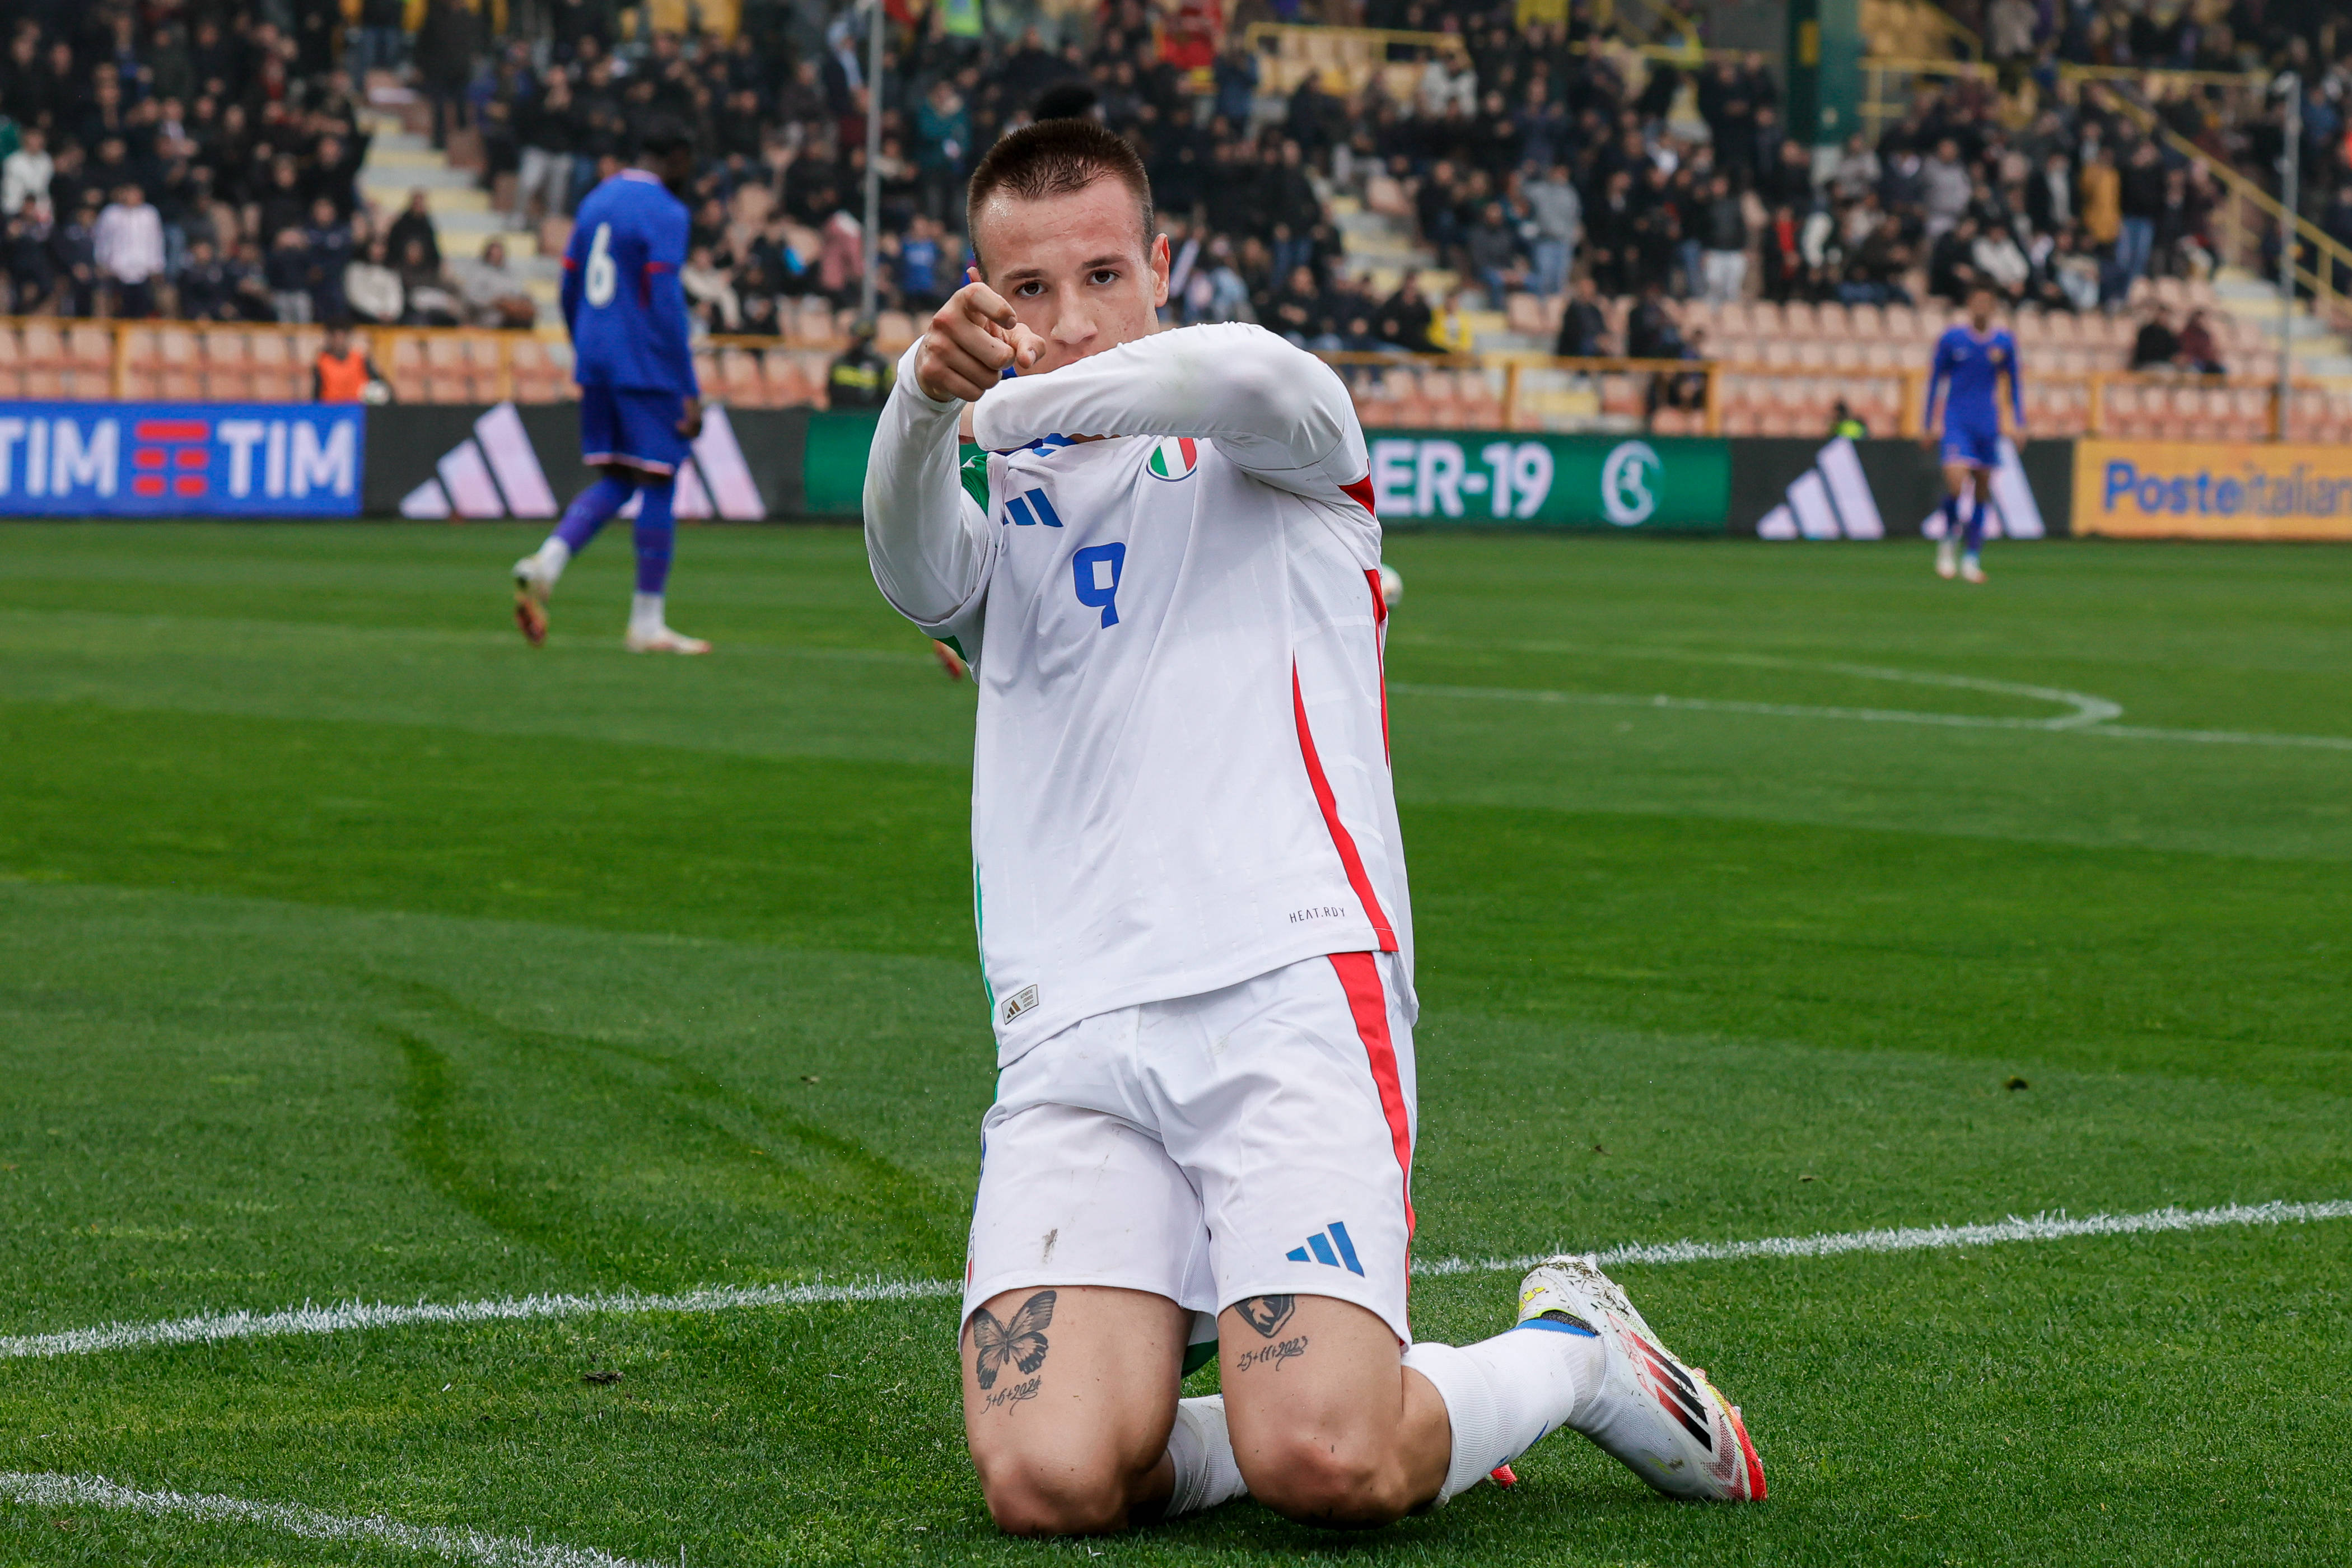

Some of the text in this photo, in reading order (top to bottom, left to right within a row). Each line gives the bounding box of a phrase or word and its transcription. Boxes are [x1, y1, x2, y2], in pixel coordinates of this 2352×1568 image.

[585, 222, 617, 306] 6
[0, 418, 356, 498] TIM TIM
[1072, 542, 1126, 629] 9
[1289, 906, 1345, 923] HEAT.RDY
